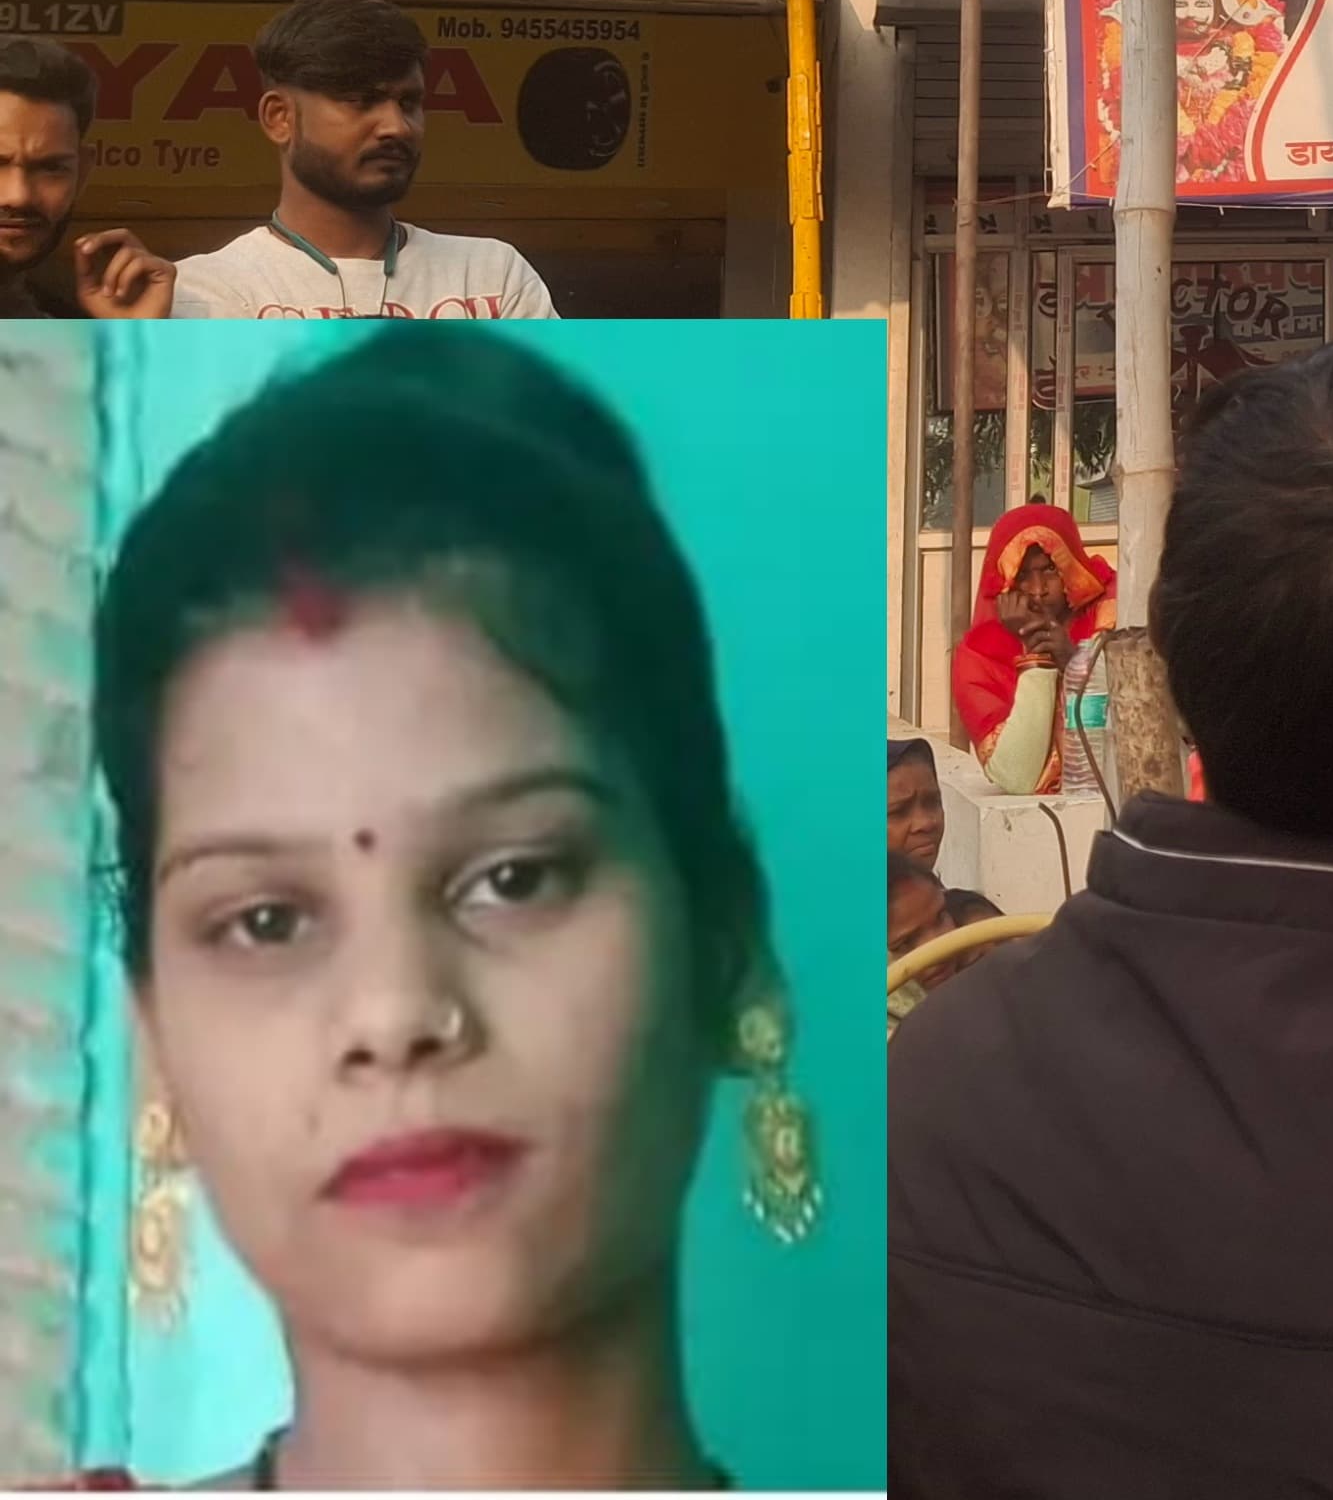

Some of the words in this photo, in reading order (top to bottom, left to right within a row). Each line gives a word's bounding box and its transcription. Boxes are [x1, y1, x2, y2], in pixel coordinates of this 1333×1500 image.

[437, 17, 493, 39] Mob.
[500, 17, 641, 41] 9455455954
[153, 139, 221, 175] Tyre
